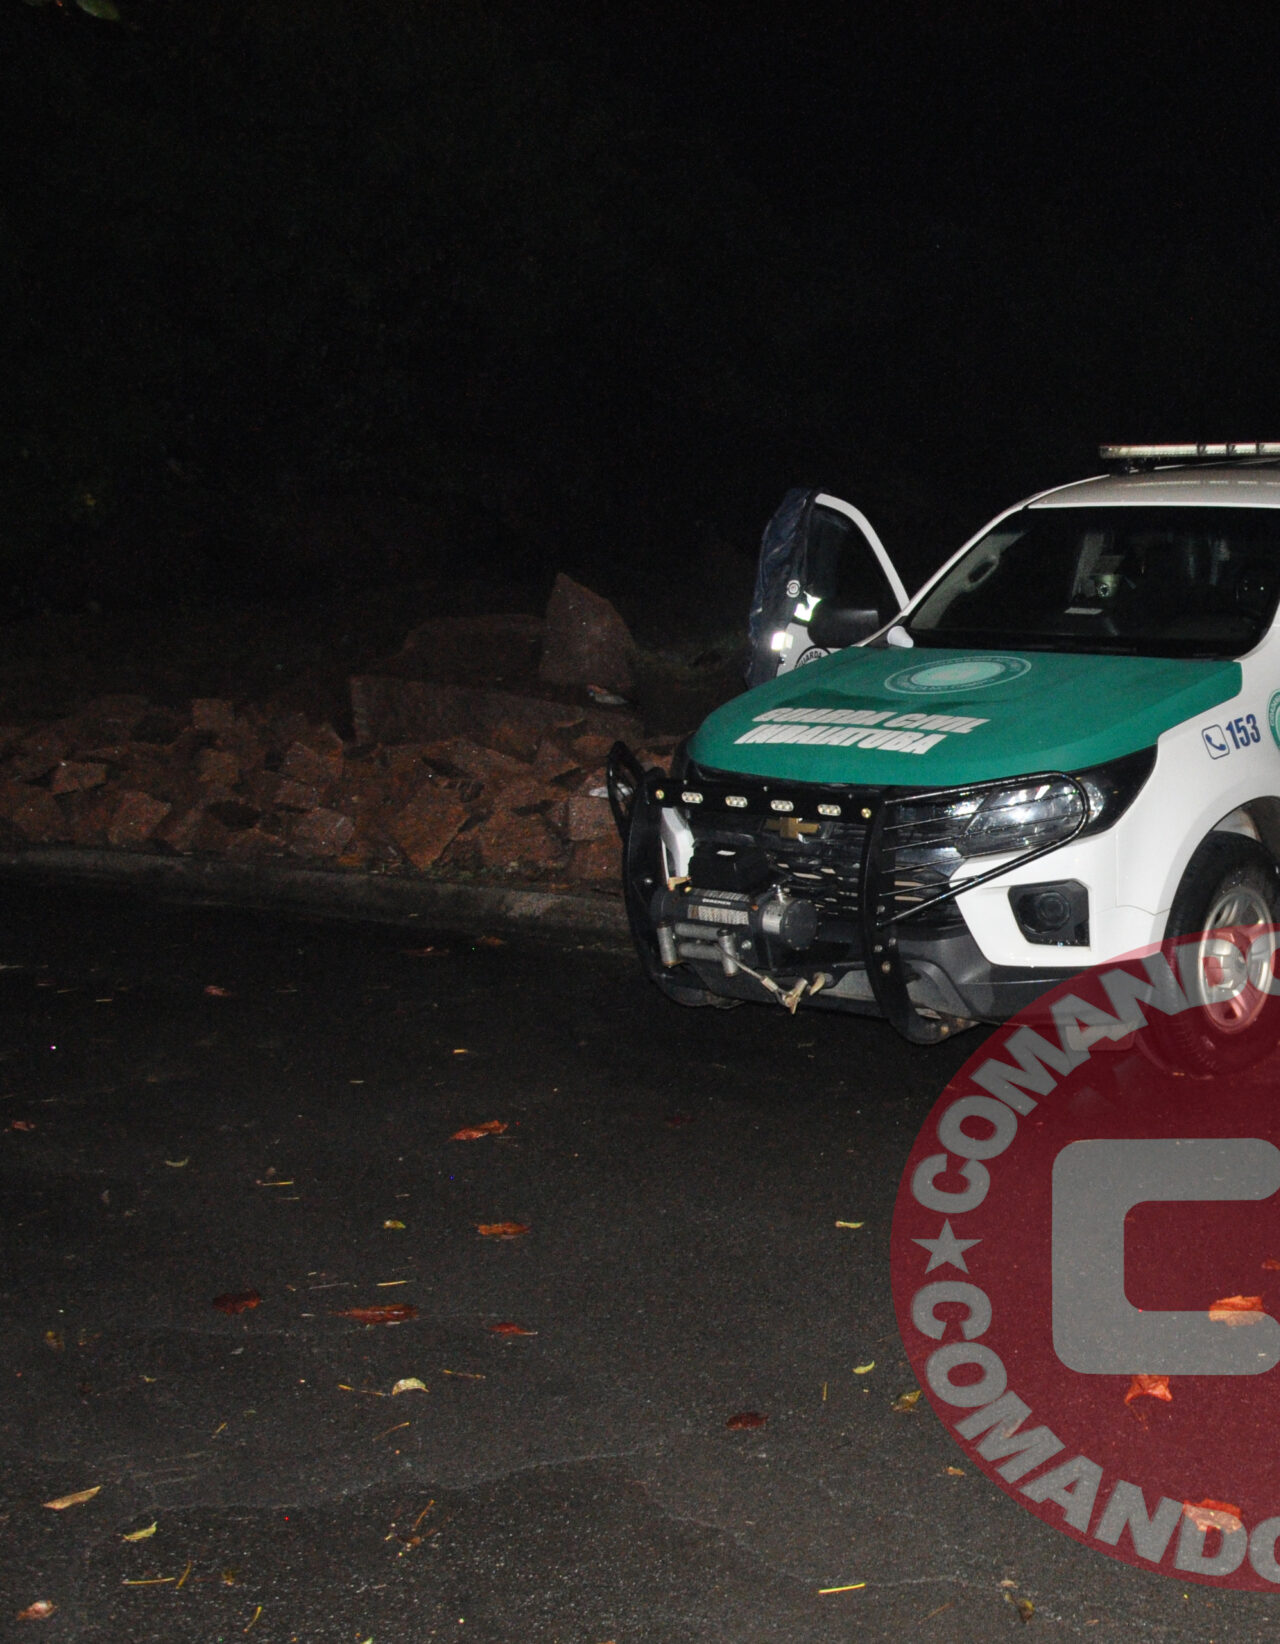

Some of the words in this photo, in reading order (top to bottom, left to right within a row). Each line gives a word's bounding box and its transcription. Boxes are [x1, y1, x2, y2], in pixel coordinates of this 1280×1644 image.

[801, 651, 822, 665] UARDA
[752, 707, 898, 726] GUARDA
[883, 713, 991, 734] CIVIL
[1225, 713, 1261, 750] 153
[733, 724, 948, 755] INDAIATUBA
